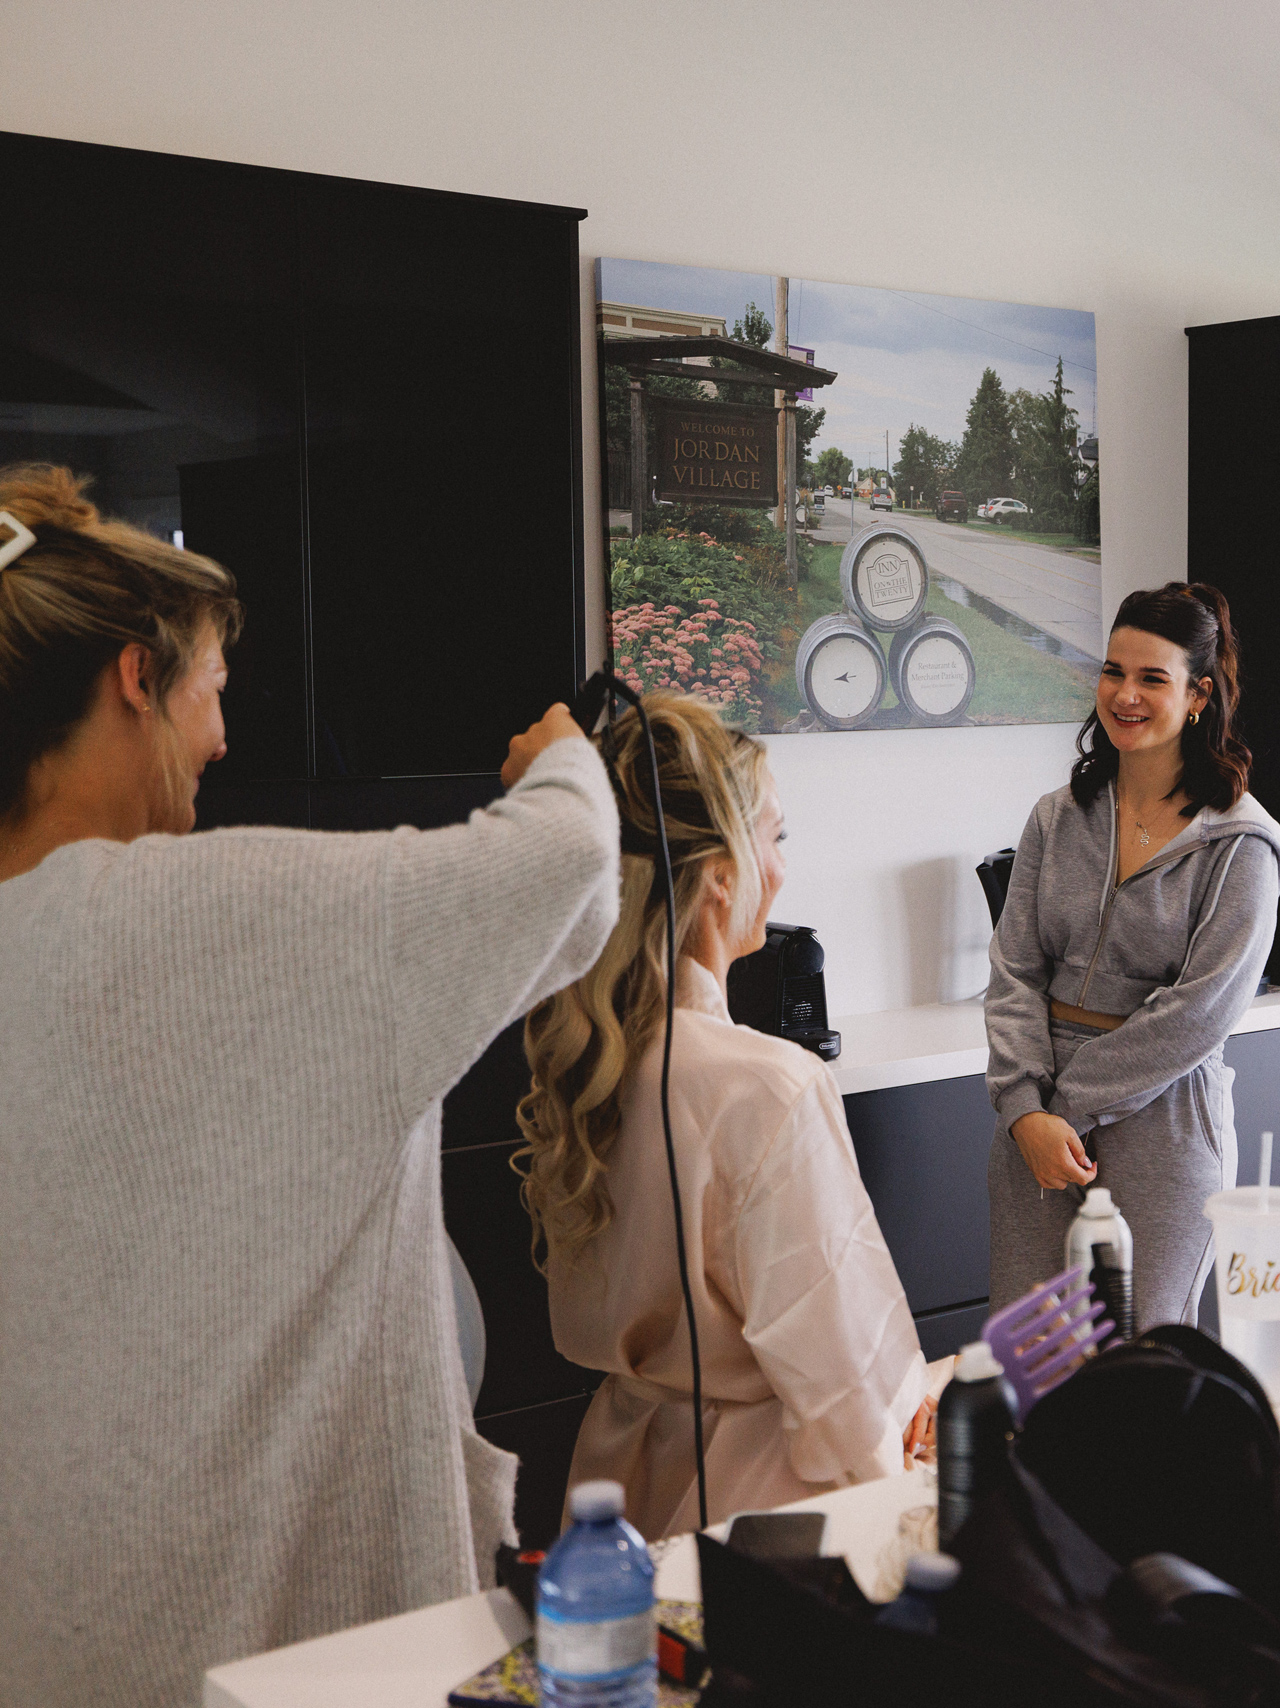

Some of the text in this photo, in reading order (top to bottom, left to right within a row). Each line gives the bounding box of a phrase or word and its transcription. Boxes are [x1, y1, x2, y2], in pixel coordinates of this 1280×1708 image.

[680, 421, 755, 437] WELCOME TO
[673, 438, 760, 463] JORDAN
[672, 465, 760, 490] VILLAGE
[877, 560, 898, 574] INN
[873, 577, 907, 590] ON THE
[875, 586, 908, 599] TWENTY
[917, 660, 957, 671] Restaurant &
[911, 671, 965, 681] Merchant Parking
